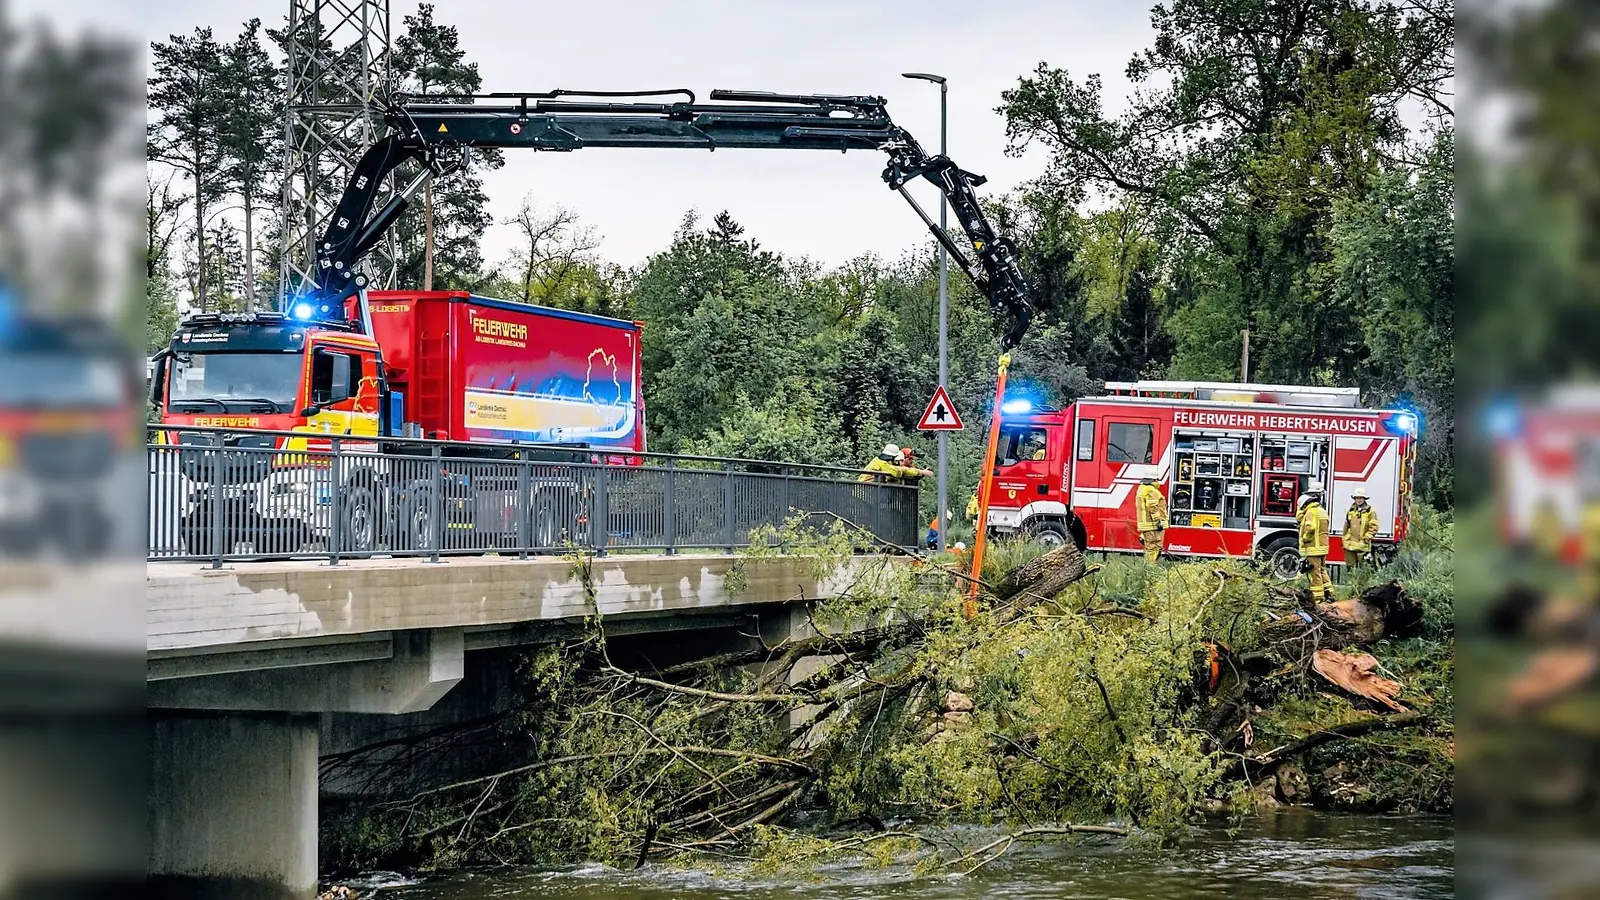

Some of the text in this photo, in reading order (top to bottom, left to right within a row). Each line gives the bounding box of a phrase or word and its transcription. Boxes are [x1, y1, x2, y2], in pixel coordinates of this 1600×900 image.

[355, 175, 369, 190] 525
[369, 305, 410, 313] B-LOGISTIK
[473, 317, 528, 341] FEUERWEHR
[194, 417, 259, 427] FEUERWEHR
[1173, 411, 1376, 433] FEUERWEHR HEBERTSHAUSEN
